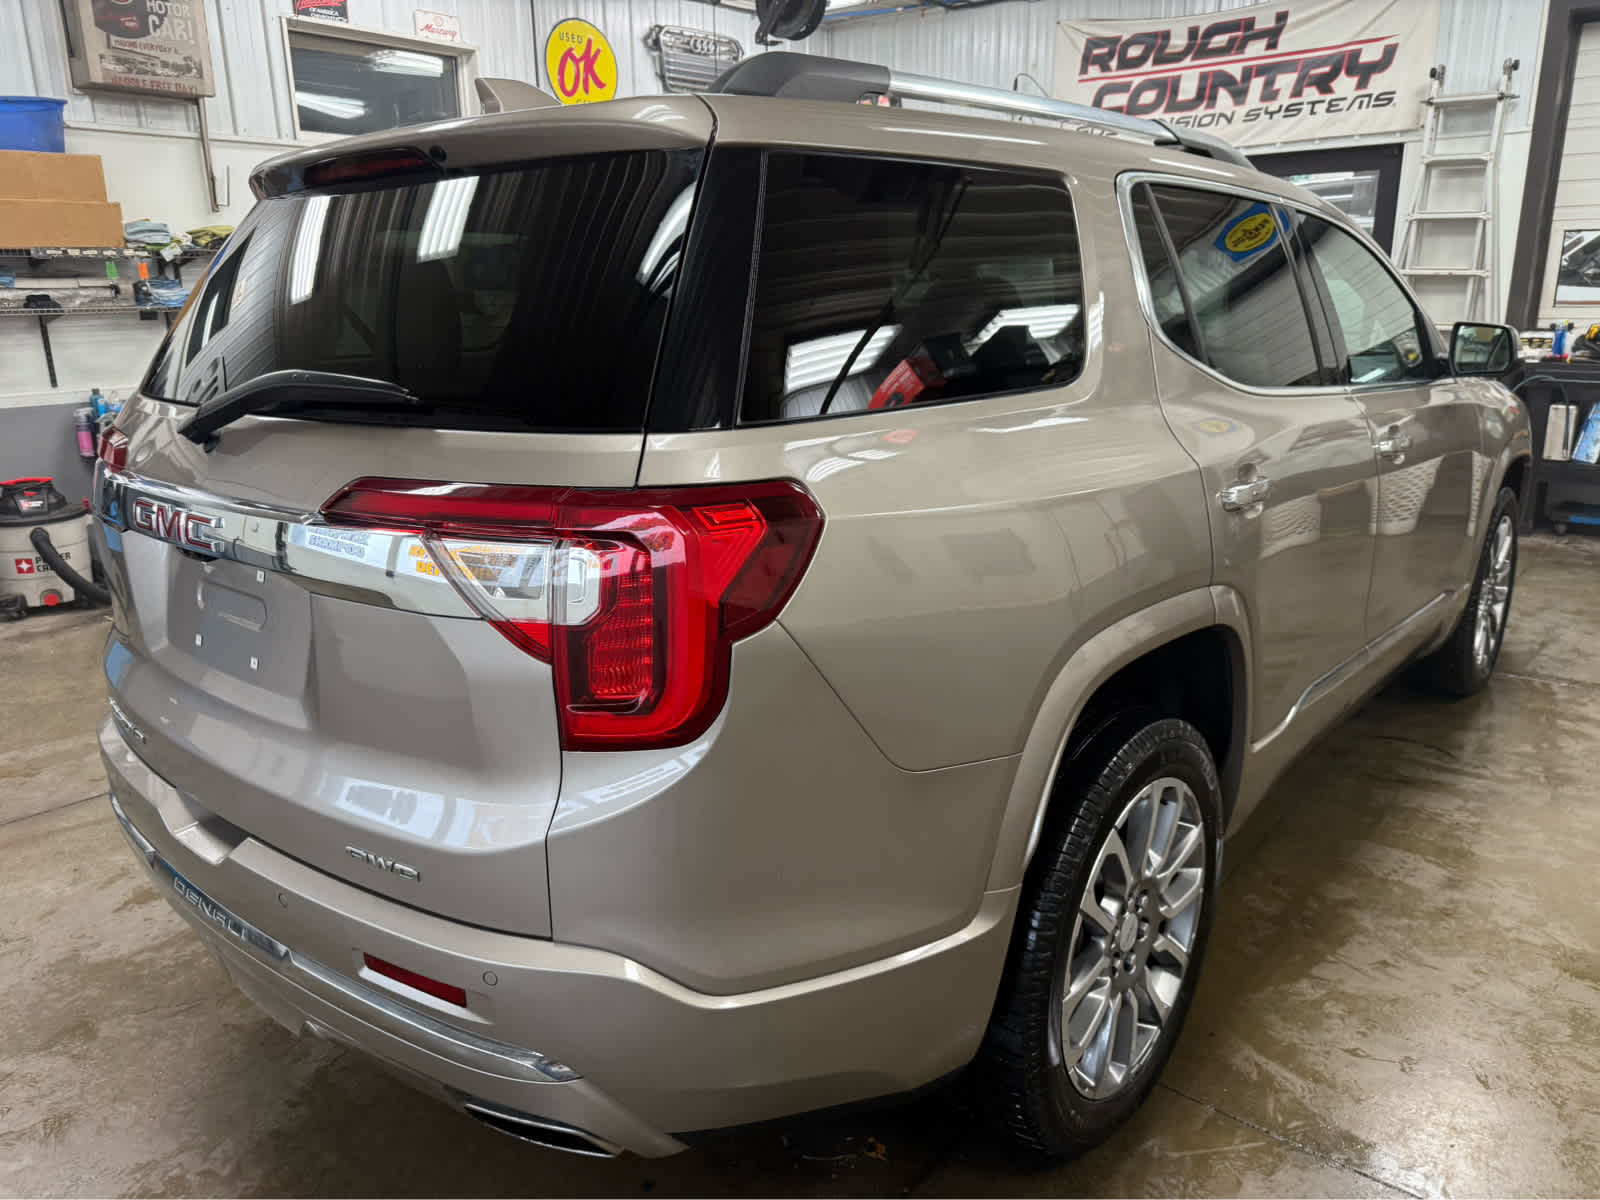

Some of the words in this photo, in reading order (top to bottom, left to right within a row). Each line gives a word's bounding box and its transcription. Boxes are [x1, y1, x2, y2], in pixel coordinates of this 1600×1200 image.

[146, 0, 191, 17] MOTOR
[148, 14, 196, 44] CAR!
[560, 31, 583, 44] USED
[1079, 10, 1289, 76] ROUGH
[559, 37, 607, 97] OK
[1091, 43, 1399, 116] COUNTRY
[1241, 90, 1397, 123] SYSTEMS
[133, 496, 225, 553] GMC
[174, 877, 247, 941] DENALI
